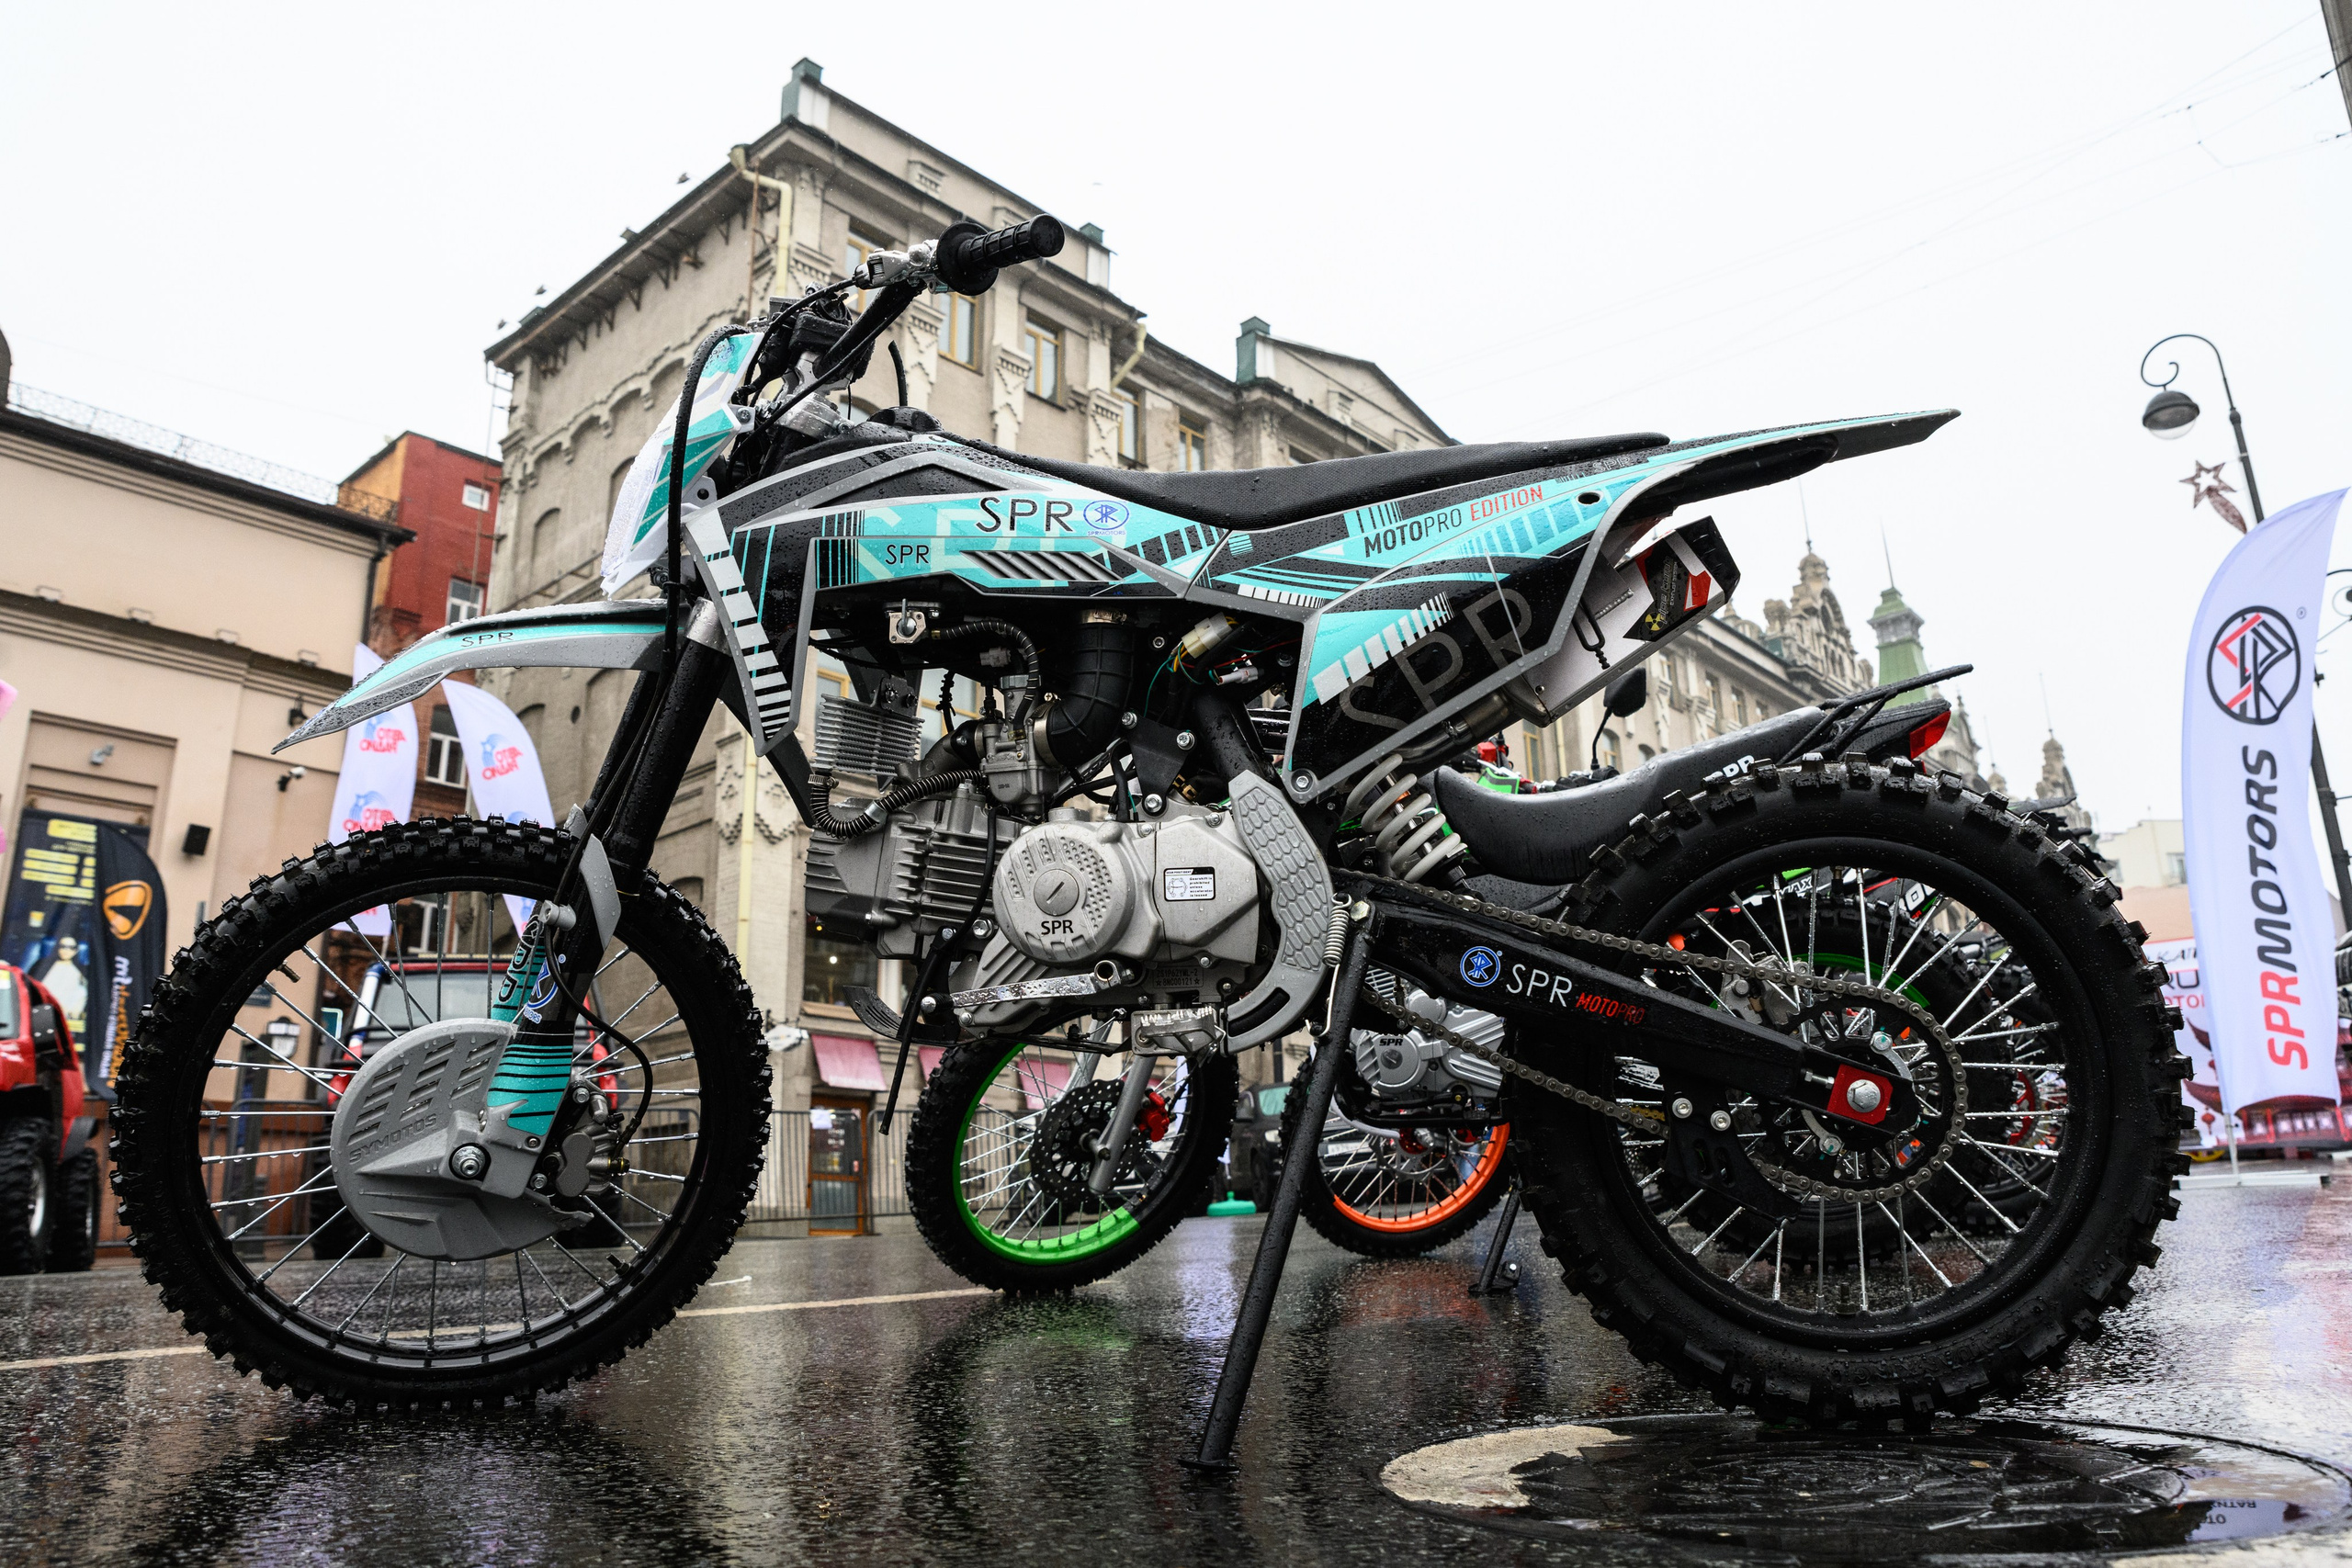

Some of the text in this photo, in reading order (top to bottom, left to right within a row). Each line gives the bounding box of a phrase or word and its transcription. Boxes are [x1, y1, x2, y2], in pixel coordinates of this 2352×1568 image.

[976, 497, 1073, 533] SPR
[1364, 485, 1544, 558] MOTOPRO EDITION
[885, 544, 930, 565] SPR
[461, 632, 514, 648] SPR
[2242, 745, 2308, 1070] SPRMOTORS
[1041, 919, 1074, 935] SPR
[1506, 964, 1645, 1024] SPR MOTOPRO
[1379, 1038, 1404, 1046] SPR
